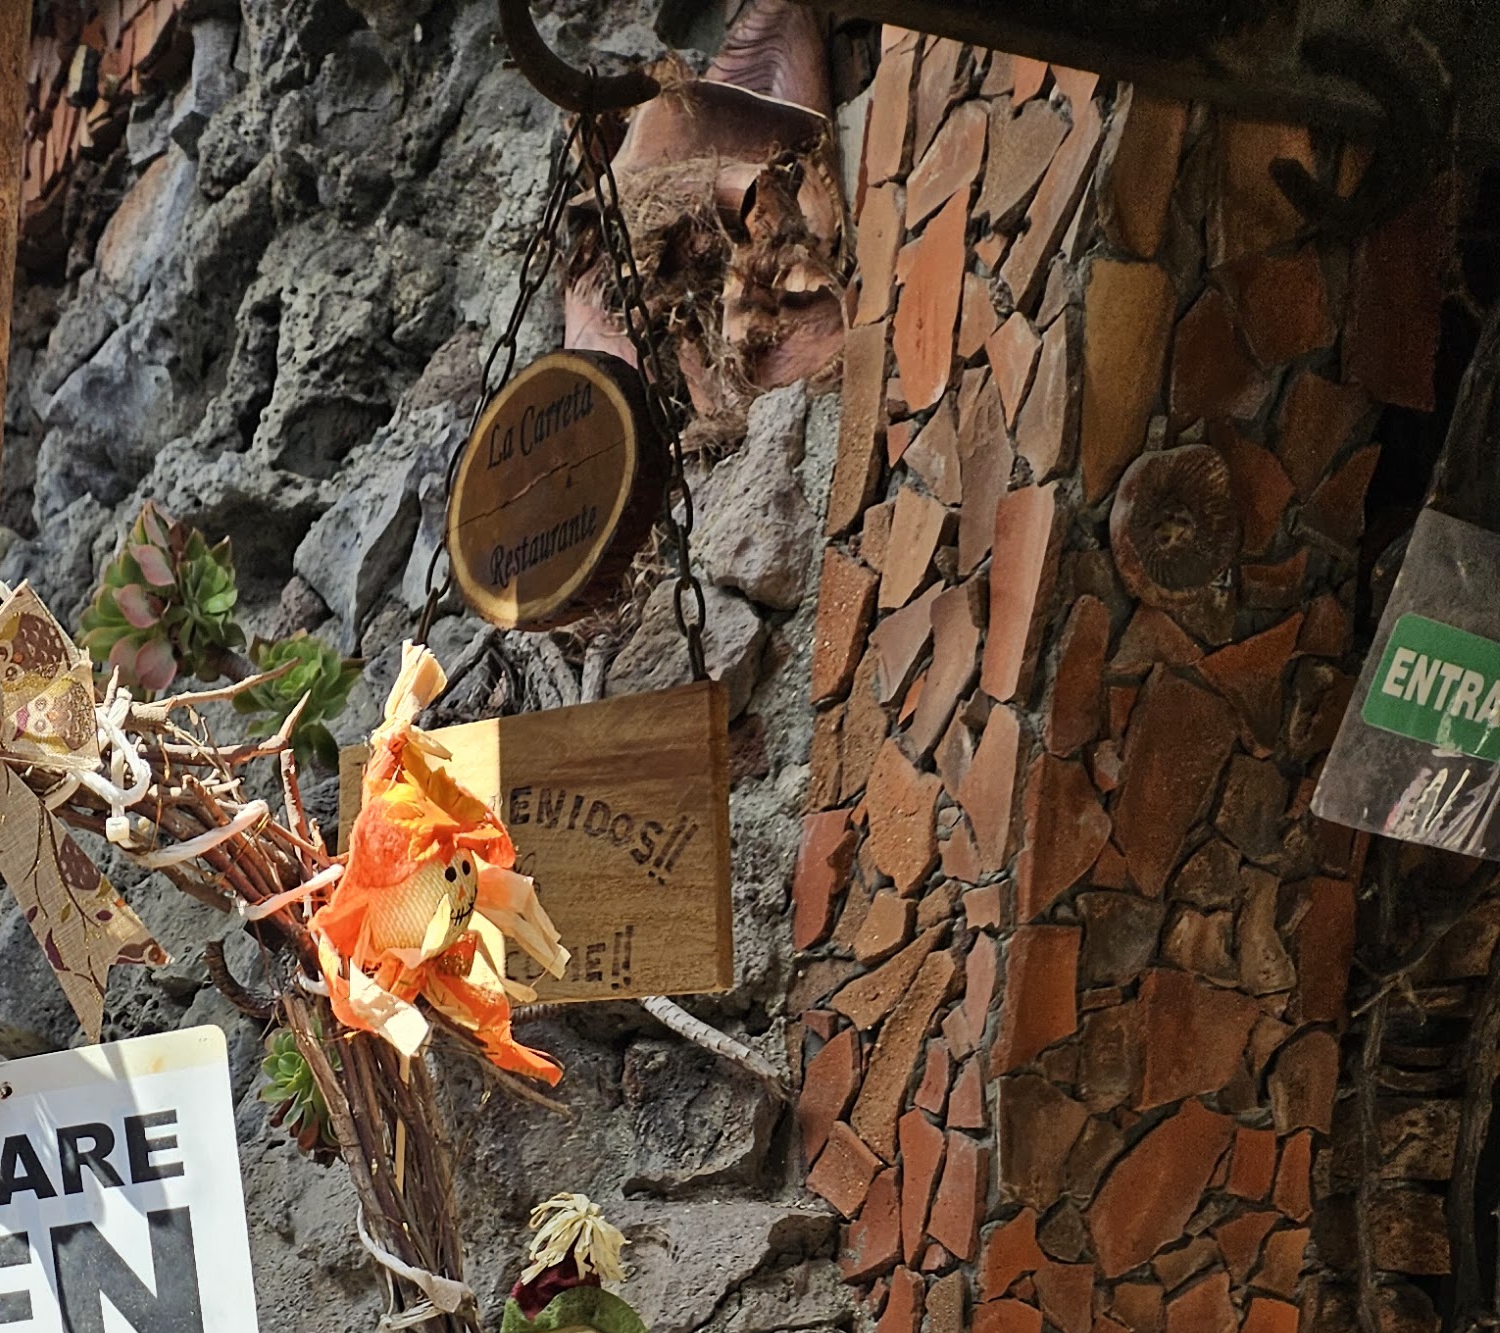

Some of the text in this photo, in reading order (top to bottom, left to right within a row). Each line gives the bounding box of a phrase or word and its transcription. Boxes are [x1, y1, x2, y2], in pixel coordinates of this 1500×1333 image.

[487, 381, 593, 471] La Carreta
[490, 504, 597, 589] Restaurante
[508, 784, 699, 886] ENIDOS!!
